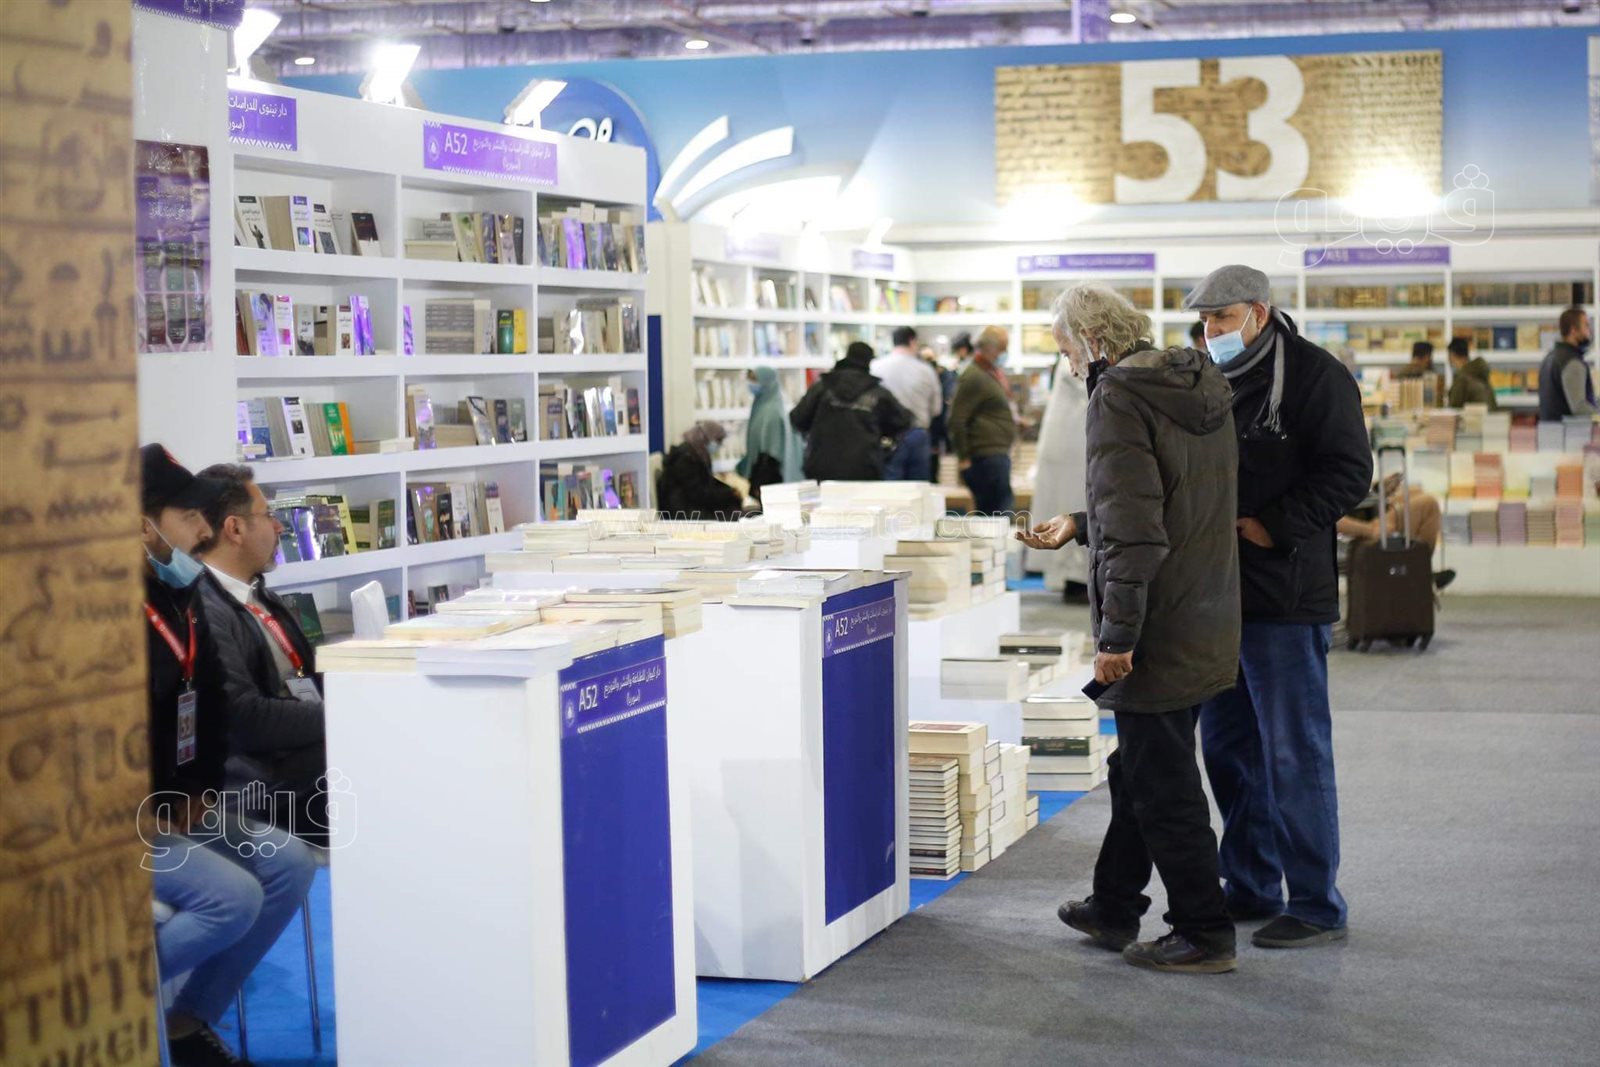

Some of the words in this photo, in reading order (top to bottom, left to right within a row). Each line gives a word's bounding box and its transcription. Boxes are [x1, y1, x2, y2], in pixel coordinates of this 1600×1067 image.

[227, 95, 258, 113] للدراسات
[259, 103, 277, 117] نينوى
[277, 103, 288, 118] دار
[1114, 55, 1310, 204] 53
[444, 131, 468, 155] A52
[834, 616, 849, 638] A52
[579, 684, 598, 712] A52
